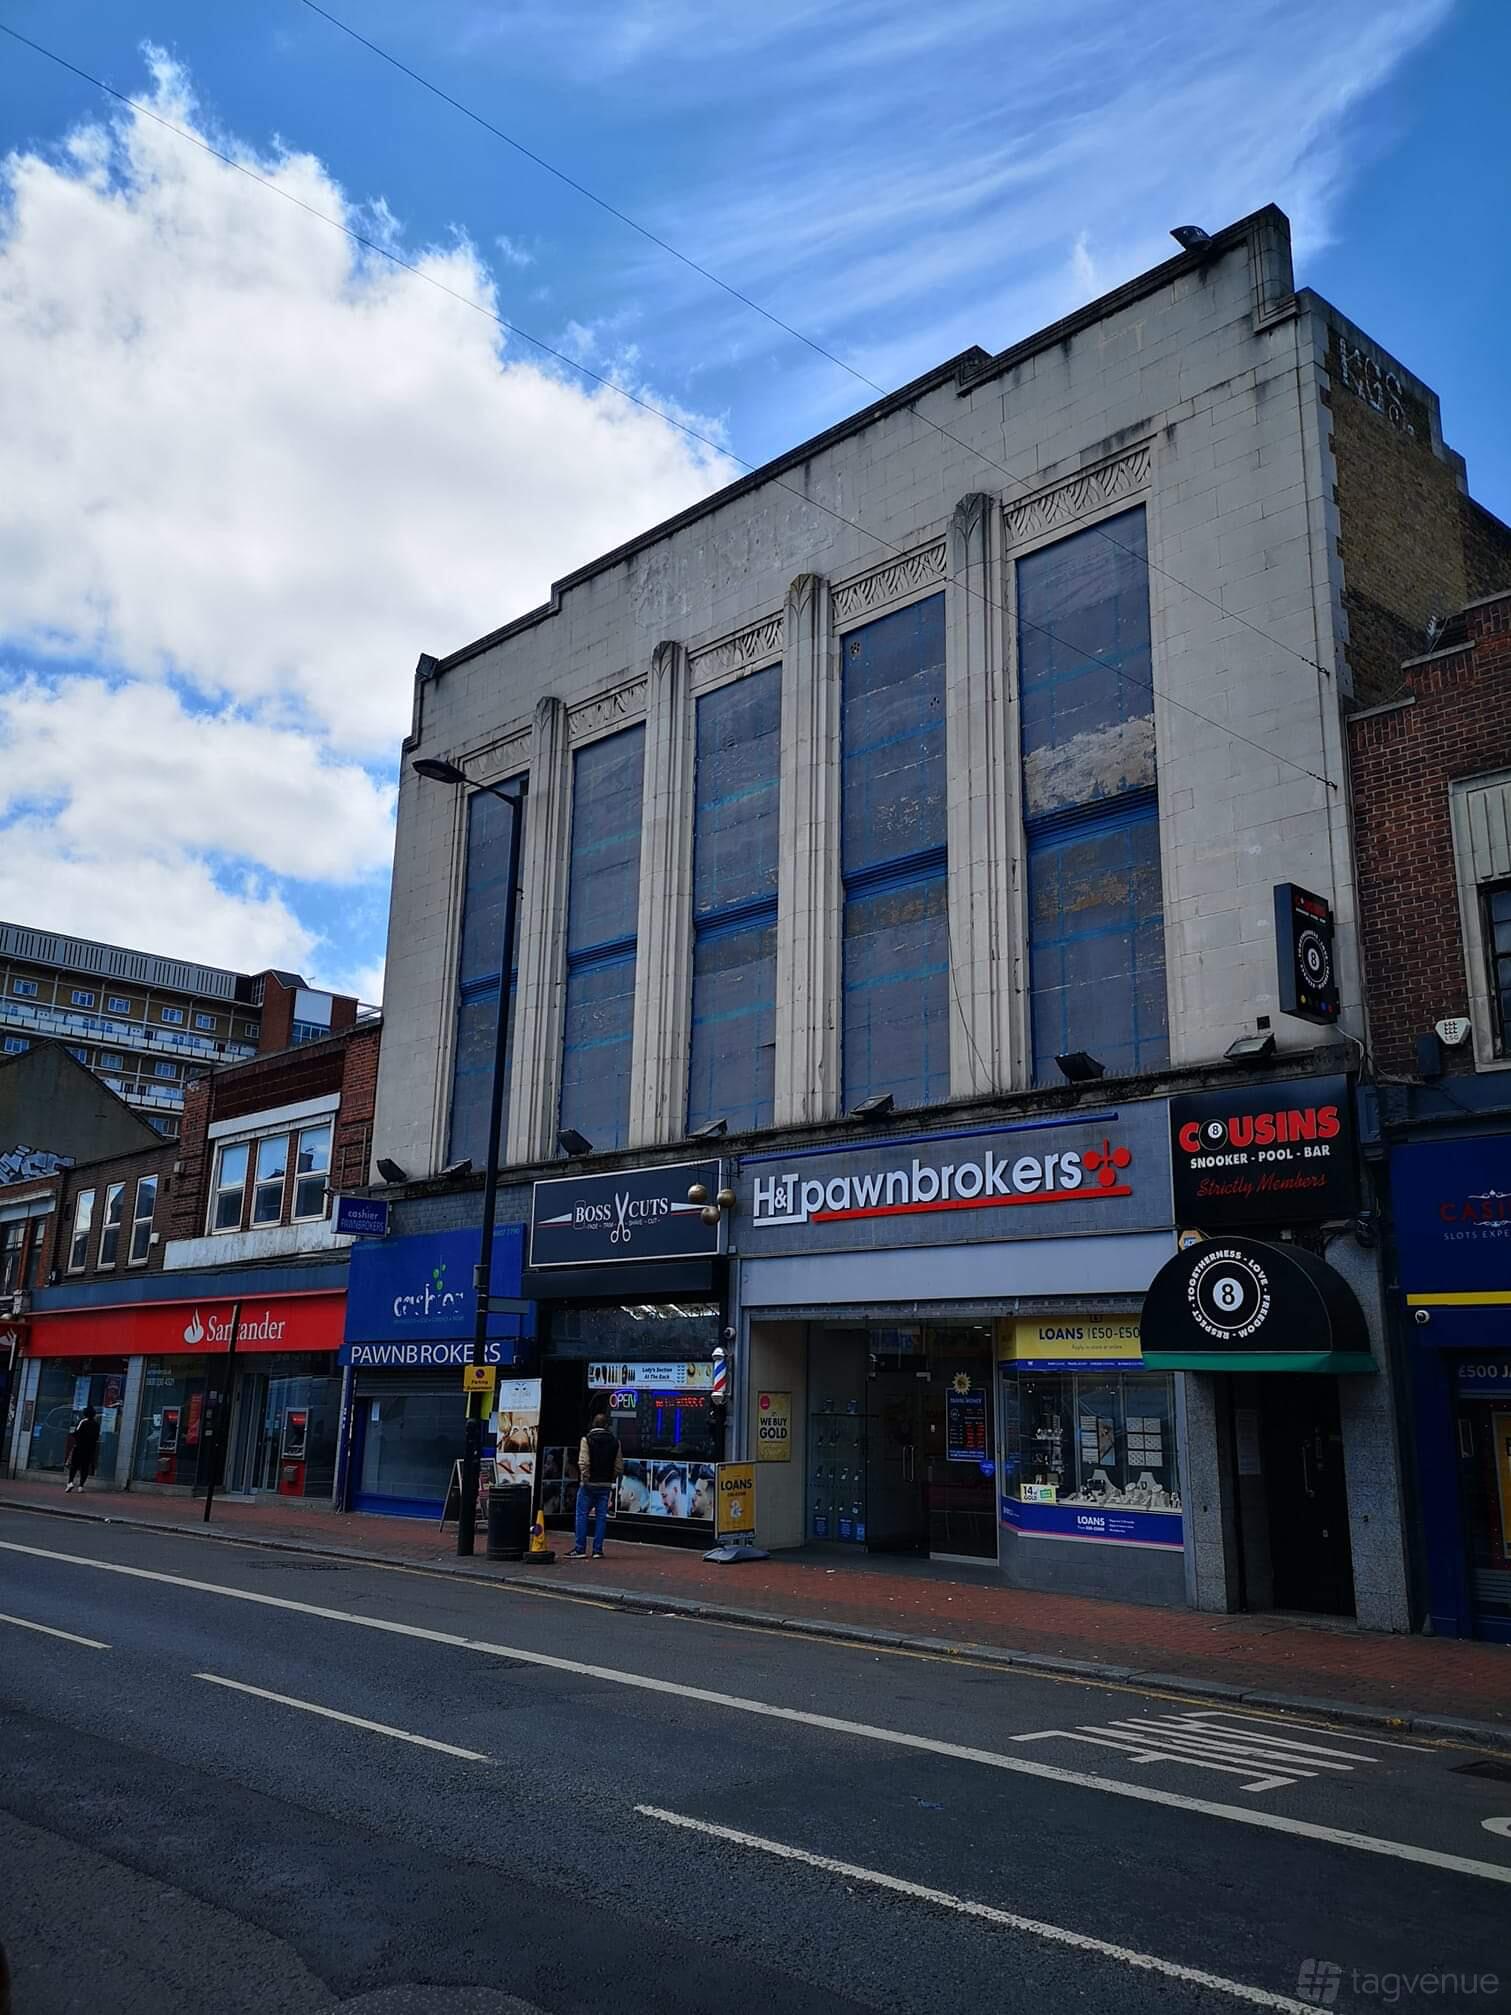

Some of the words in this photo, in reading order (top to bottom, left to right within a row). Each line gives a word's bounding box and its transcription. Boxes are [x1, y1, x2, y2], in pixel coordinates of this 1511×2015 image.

[1178, 1105, 1340, 1153] COUSINS
[1190, 1153, 1248, 1169] SNOOKER
[1258, 1149, 1293, 1162] POOL
[1304, 1145, 1331, 1158] BAR
[803, 1151, 1084, 1223] pawnbrokers
[1196, 1175, 1253, 1198] Strictly
[1257, 1169, 1328, 1193] Members
[347, 1207, 378, 1220] cashier
[575, 1204, 611, 1223] BOSS
[628, 1197, 669, 1218] CUTS
[1439, 1200, 1511, 1223] CASI
[1443, 1231, 1477, 1240] SLOTS
[1248, 1259, 1268, 1286] LOVE
[1222, 1283, 1235, 1305] 8
[206, 1311, 286, 1342] Sanander
[1191, 1310, 1230, 1340] RESPECT
[1238, 1295, 1270, 1338] FREEDOM
[1039, 1328, 1083, 1340] LOANS
[1457, 1364, 1498, 1378] £500
[1501, 1364, 1511, 1378] J
[608, 1393, 636, 1408] OPEN
[760, 1417, 772, 1426] WE
[773, 1416, 787, 1426] BUY
[759, 1426, 788, 1440] GOLD
[720, 1479, 752, 1491] LOANS
[1077, 1516, 1105, 1526] LOANS
